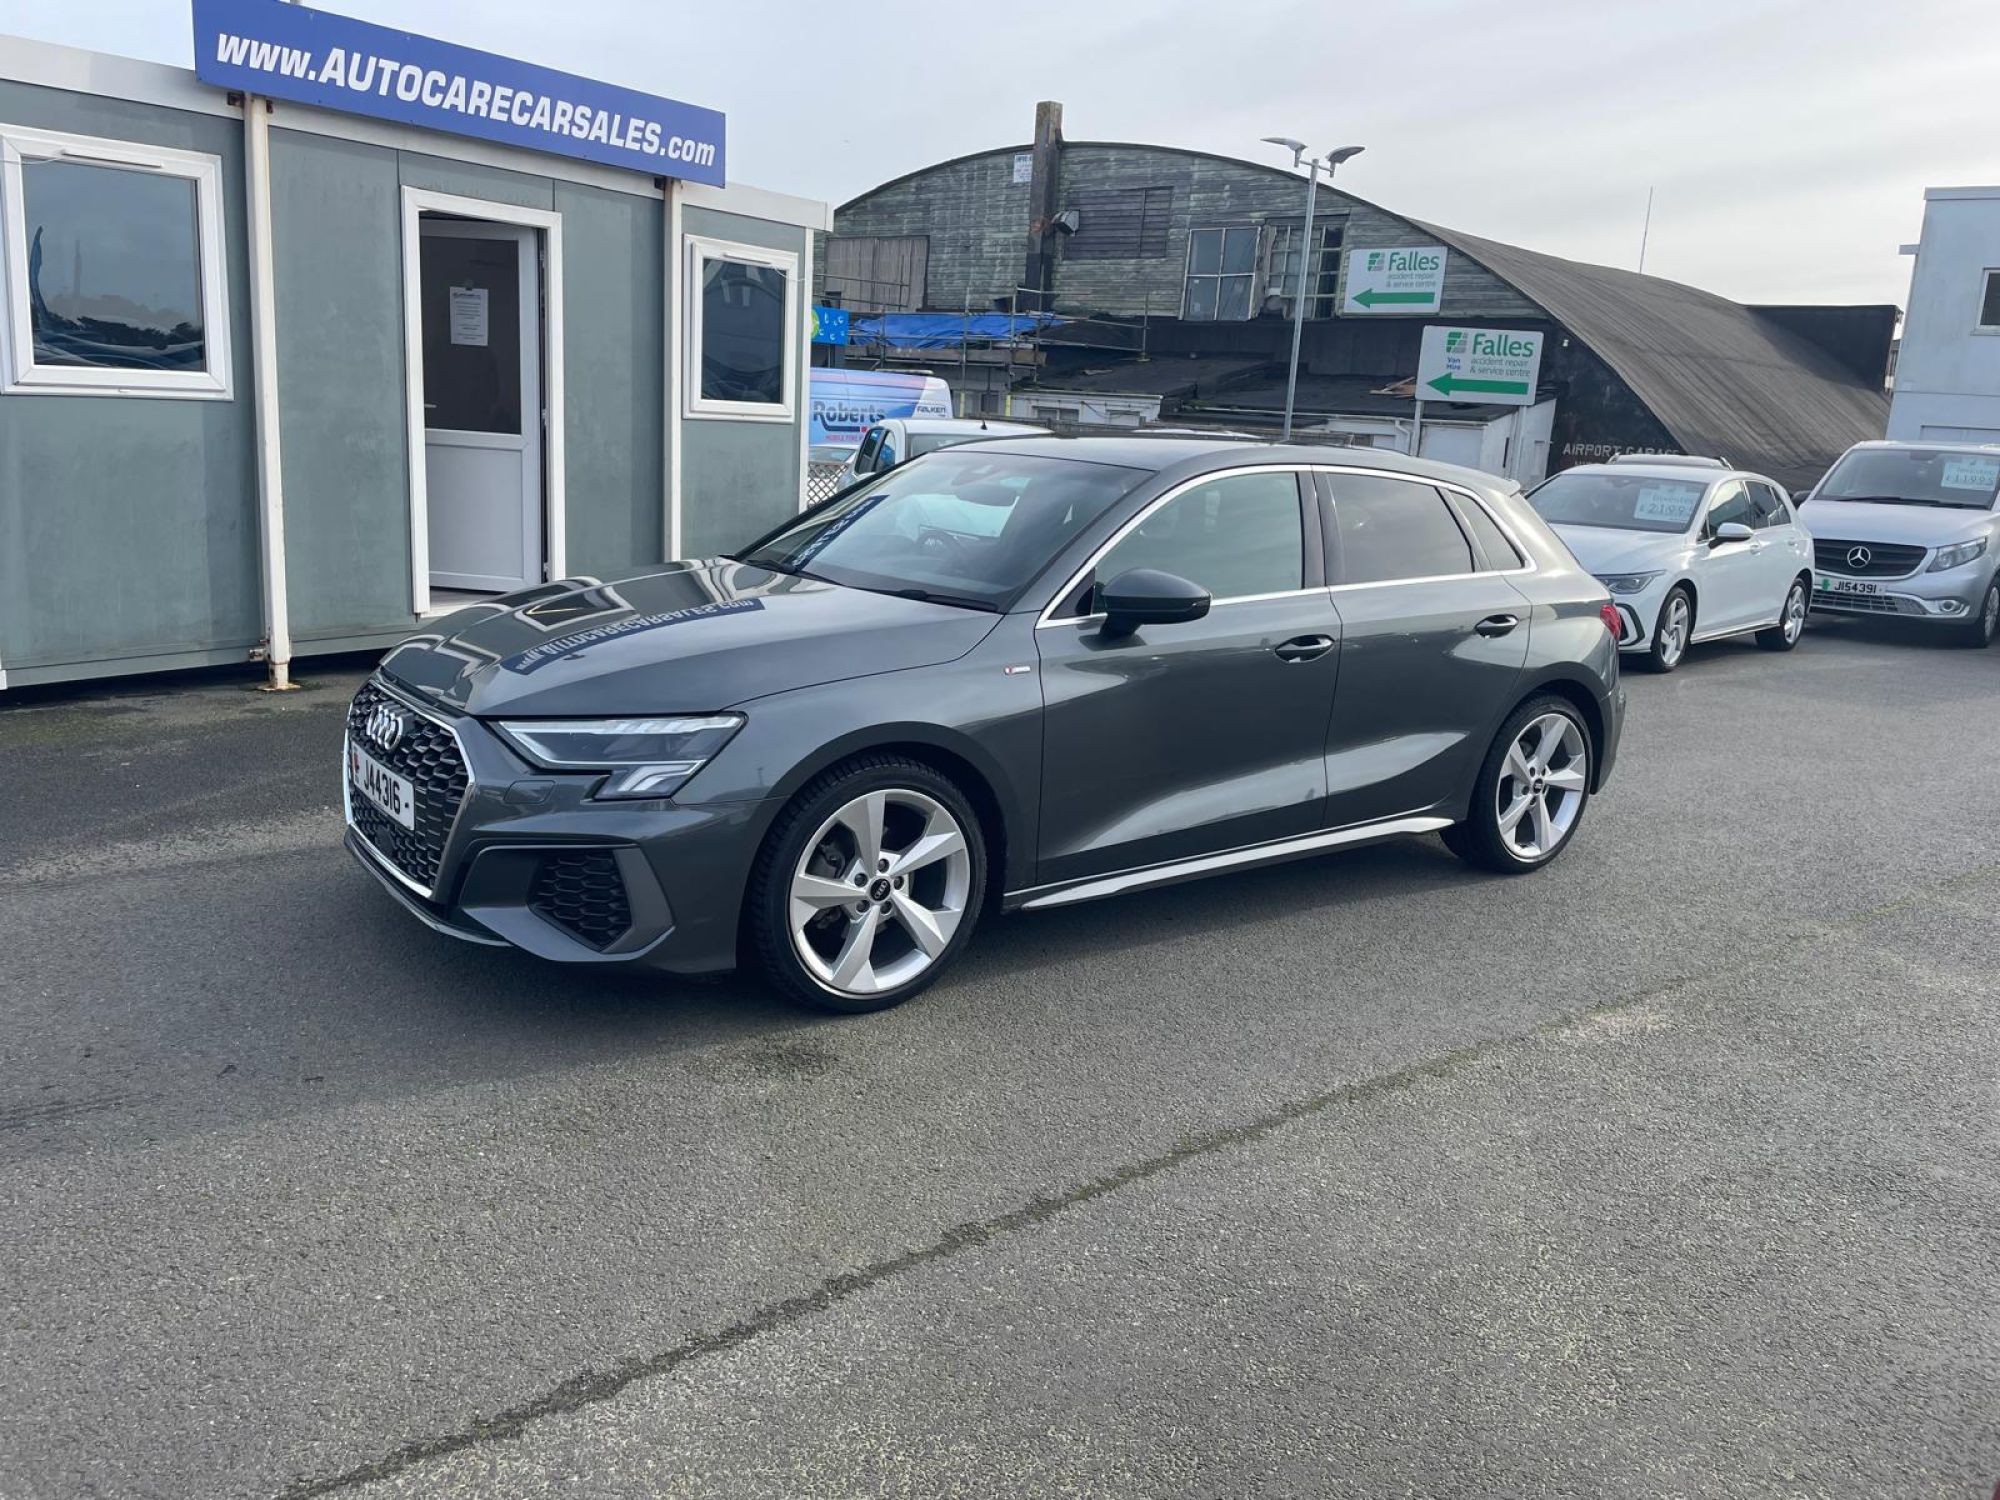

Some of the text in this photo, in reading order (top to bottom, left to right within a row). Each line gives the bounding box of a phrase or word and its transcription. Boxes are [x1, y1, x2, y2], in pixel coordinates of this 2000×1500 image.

[217, 34, 716, 167] www.AUTOCARECARSALES.com
[1388, 251, 1440, 271] Falles
[1472, 333, 1535, 358] Falles
[1470, 358, 1529, 369] accident repair
[813, 401, 886, 422] Roberts
[917, 405, 946, 414] FALKEN
[1562, 442, 1620, 457] AIRPORT
[363, 759, 401, 815] J44316
